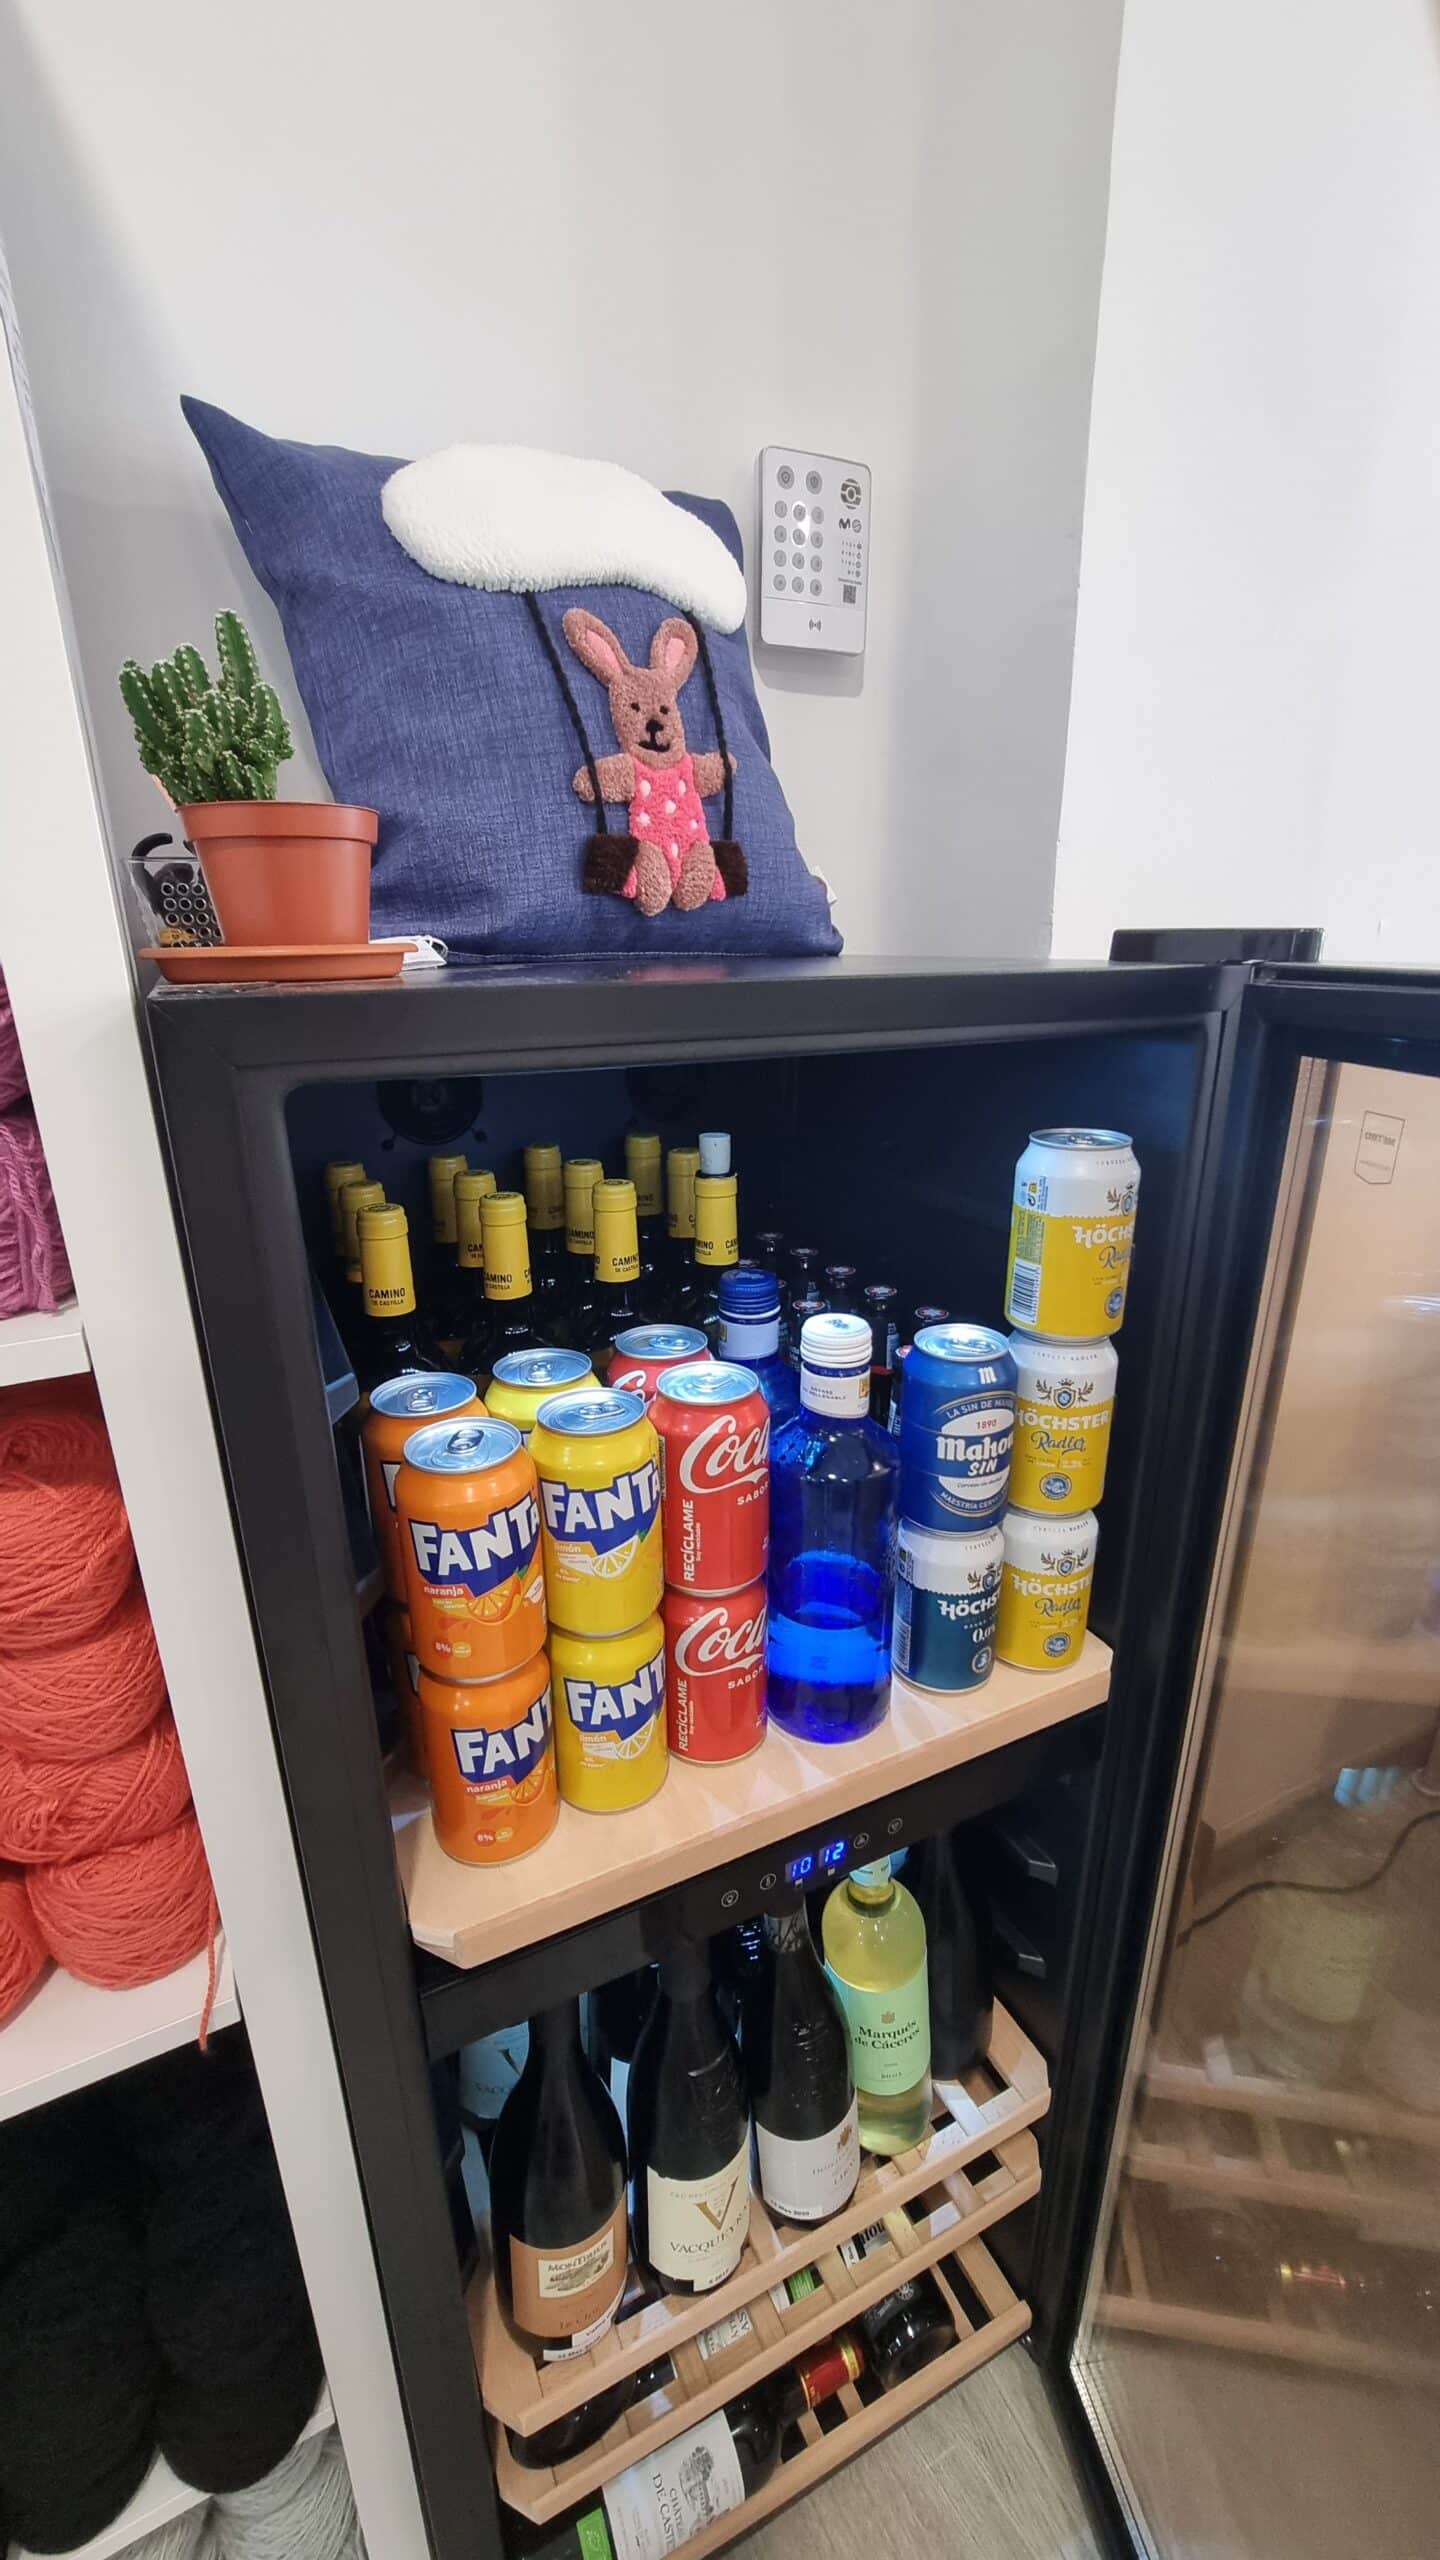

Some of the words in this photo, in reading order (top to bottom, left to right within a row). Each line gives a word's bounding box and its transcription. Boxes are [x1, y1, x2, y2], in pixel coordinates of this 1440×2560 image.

[368, 1287, 406, 1298] CAMINO
[946, 1408, 961, 1420] LA
[961, 1402, 978, 1412] SIN
[981, 1400, 993, 1409] DE
[976, 1419, 997, 1430] 1890
[1030, 1430, 1086, 1456] Radler
[968, 1458, 998, 1476] SIN
[541, 1463, 660, 1534] FANTA
[410, 1495, 541, 1575] FANTA
[681, 1499, 695, 1582] RECÍCLAME
[423, 1585, 464, 1597] naranja
[676, 1678, 688, 1751] RECÍCLAME
[466, 1779, 508, 1793] naranja
[791, 1855, 812, 1878] 10
[824, 1841, 845, 1864] 12
[854, 2036, 869, 2048] de
[871, 2029, 920, 2050] Cáceres
[858, 2019, 917, 2040] Marqués
[652, 2473, 668, 2501] DE
